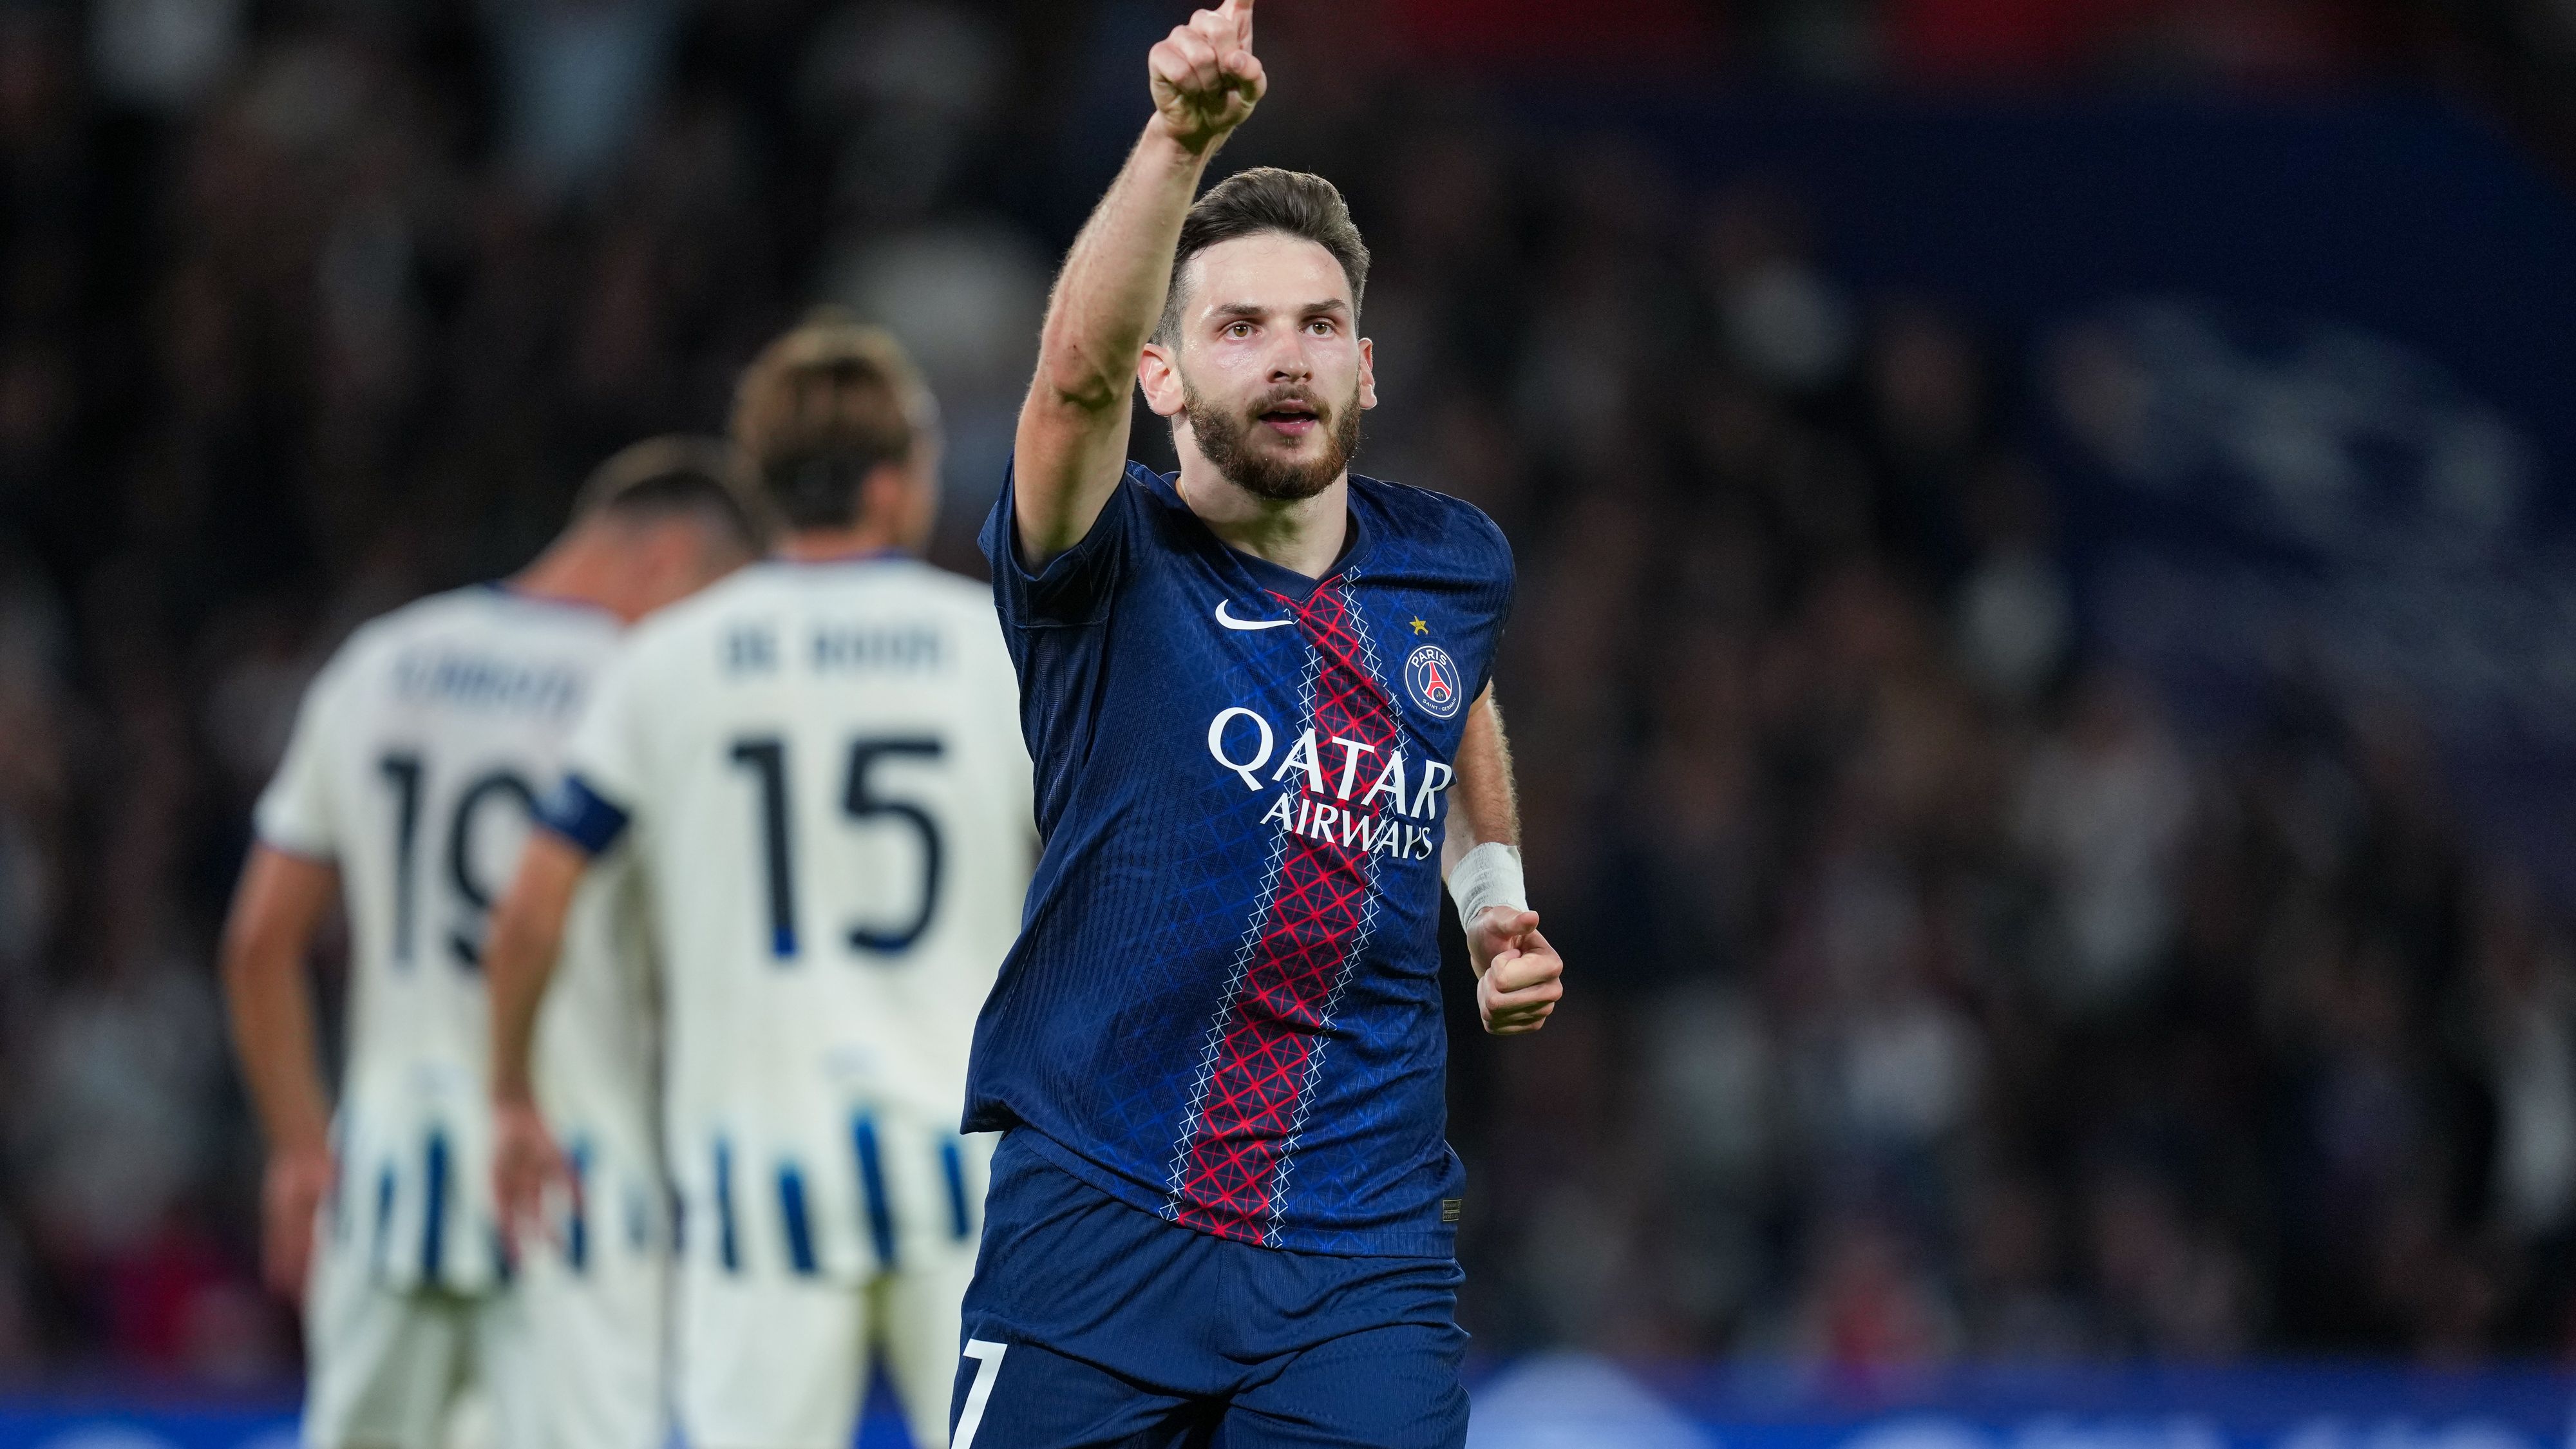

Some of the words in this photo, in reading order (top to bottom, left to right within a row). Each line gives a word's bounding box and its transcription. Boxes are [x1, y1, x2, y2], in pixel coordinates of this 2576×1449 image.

[1412, 649, 1447, 668] PARIS
[1208, 706, 1452, 820] QATAR
[380, 750, 540, 978] 19
[729, 735, 948, 958] 15
[1260, 792, 1433, 860] AIRWAYS
